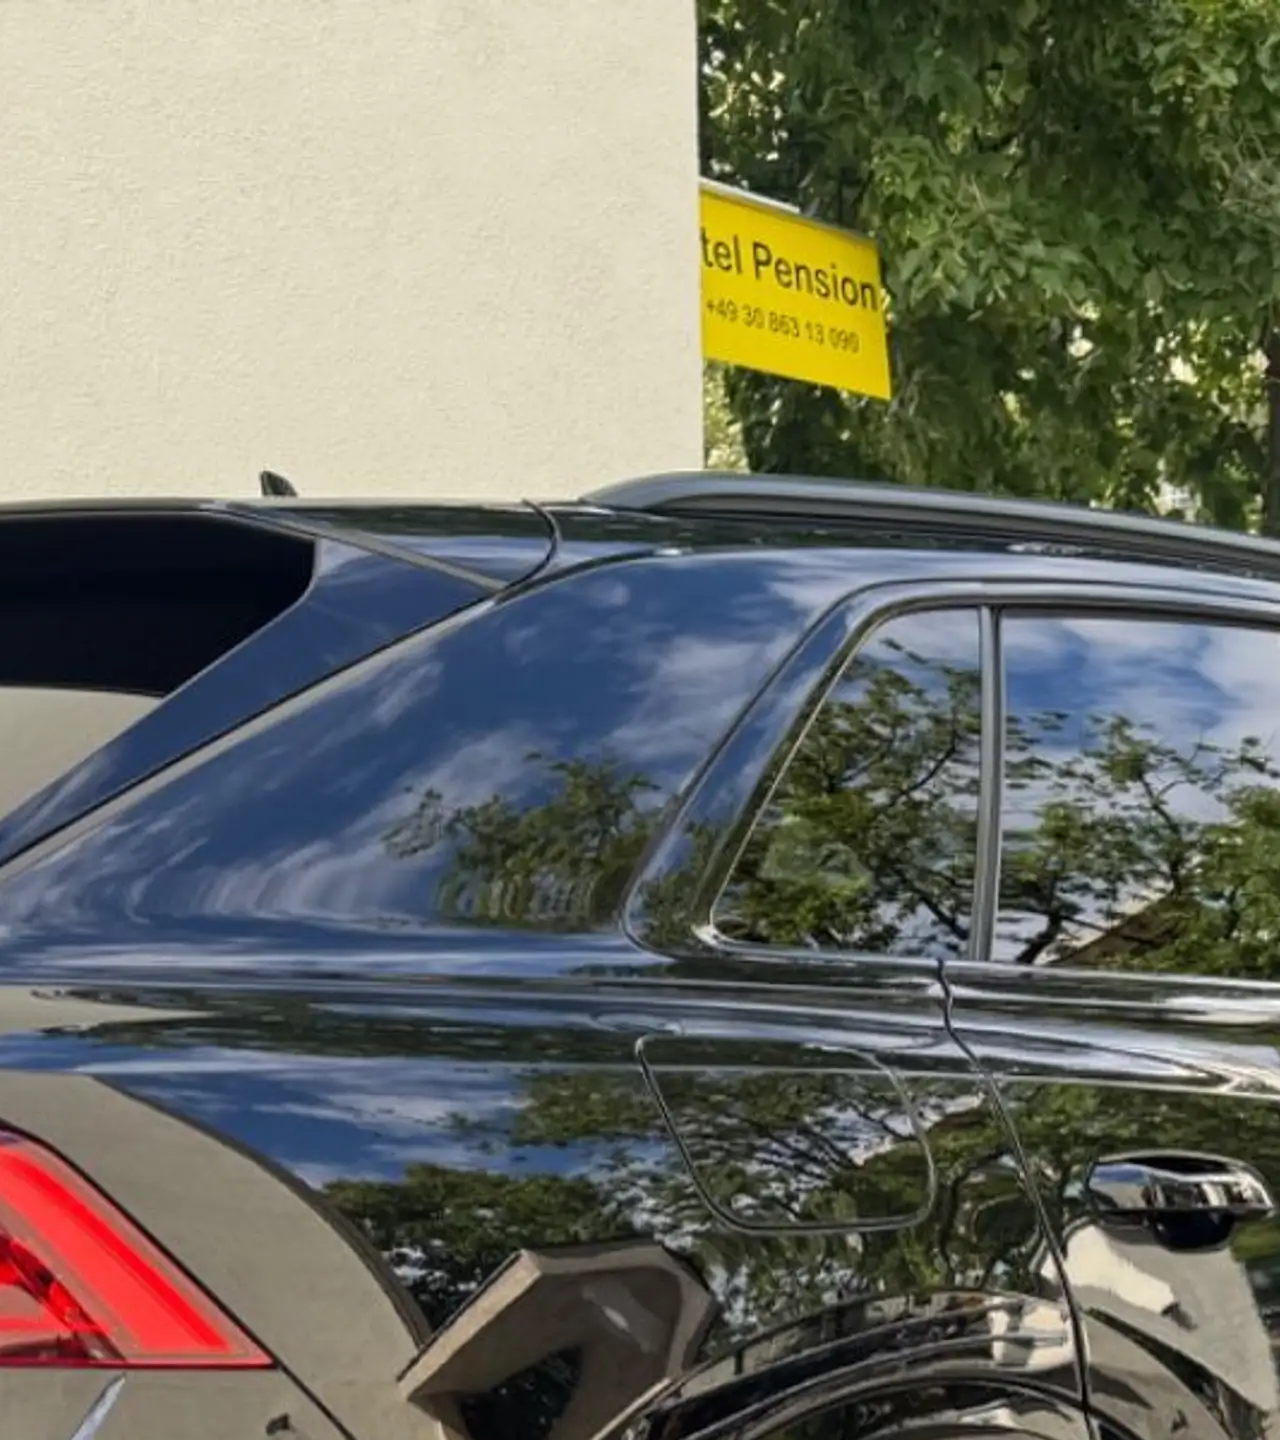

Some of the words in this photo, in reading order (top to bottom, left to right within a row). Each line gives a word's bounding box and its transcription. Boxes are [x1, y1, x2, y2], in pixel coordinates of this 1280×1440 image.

[753, 241, 878, 311] Pension
[706, 299, 738, 322] +49
[742, 304, 765, 329] 30
[805, 320, 824, 345] 13
